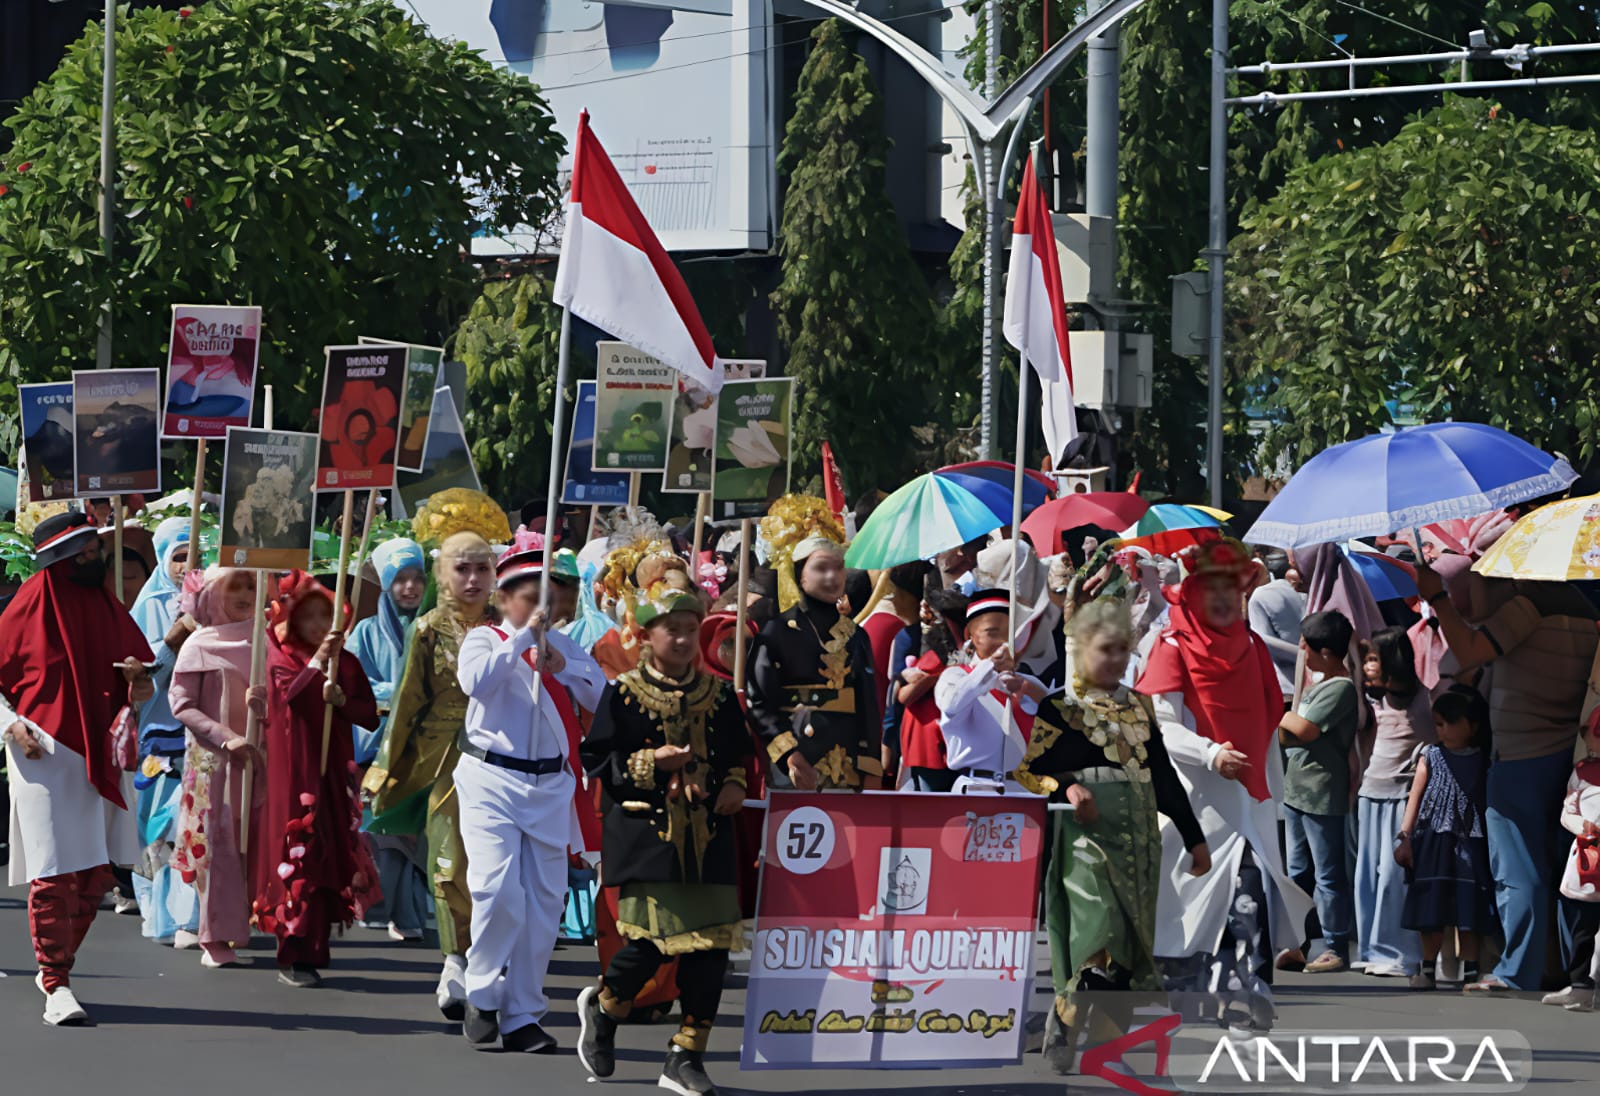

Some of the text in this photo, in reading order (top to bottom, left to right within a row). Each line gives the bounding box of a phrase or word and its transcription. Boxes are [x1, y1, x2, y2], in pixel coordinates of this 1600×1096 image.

[786, 822, 826, 860] 52
[763, 927, 808, 969] SD
[811, 928, 905, 969] ISLAM
